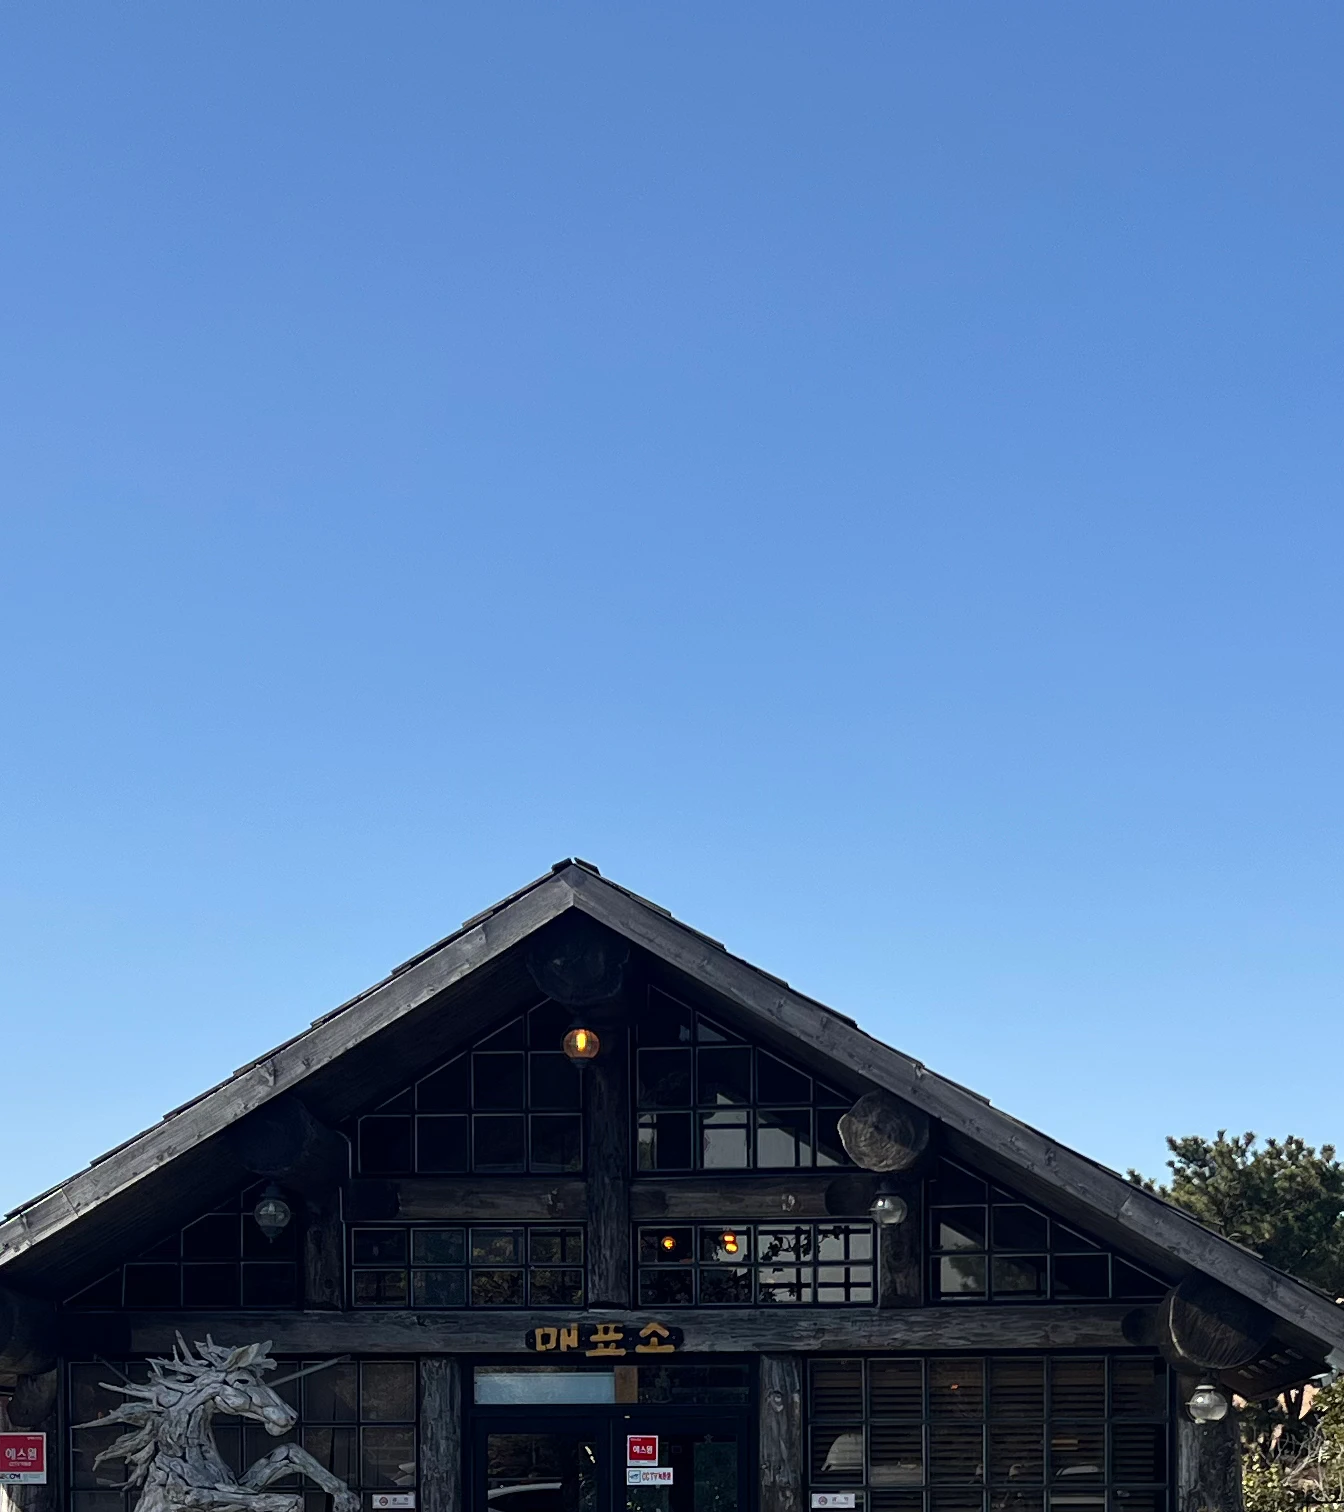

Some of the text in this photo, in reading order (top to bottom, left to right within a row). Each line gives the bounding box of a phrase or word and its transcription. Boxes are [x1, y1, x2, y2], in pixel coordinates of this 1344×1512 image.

[534, 1322, 675, 1357] 매표소
[5, 1447, 37, 1460] 에스원
[632, 1445, 653, 1455] 에스원
